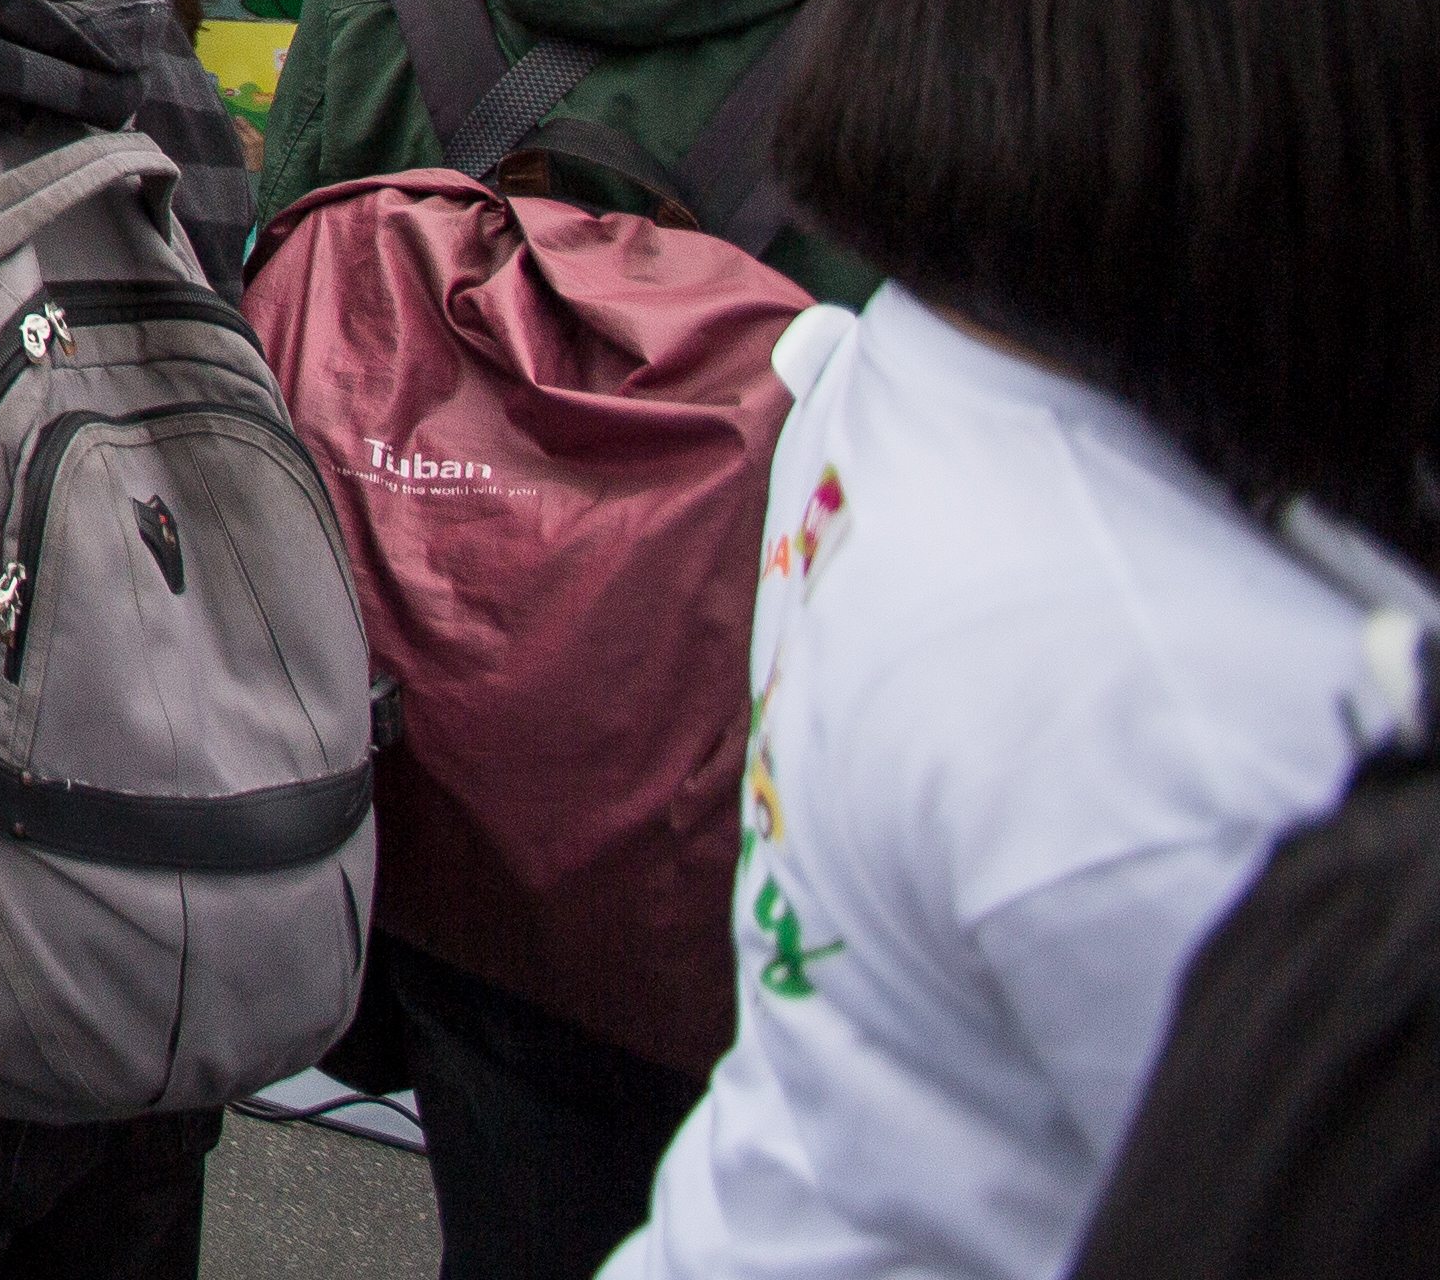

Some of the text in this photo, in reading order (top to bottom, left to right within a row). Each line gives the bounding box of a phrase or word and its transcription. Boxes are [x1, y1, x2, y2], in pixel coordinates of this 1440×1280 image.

[363, 437, 493, 480] Tuban
[401, 483, 426, 496] the
[429, 485, 470, 497] world
